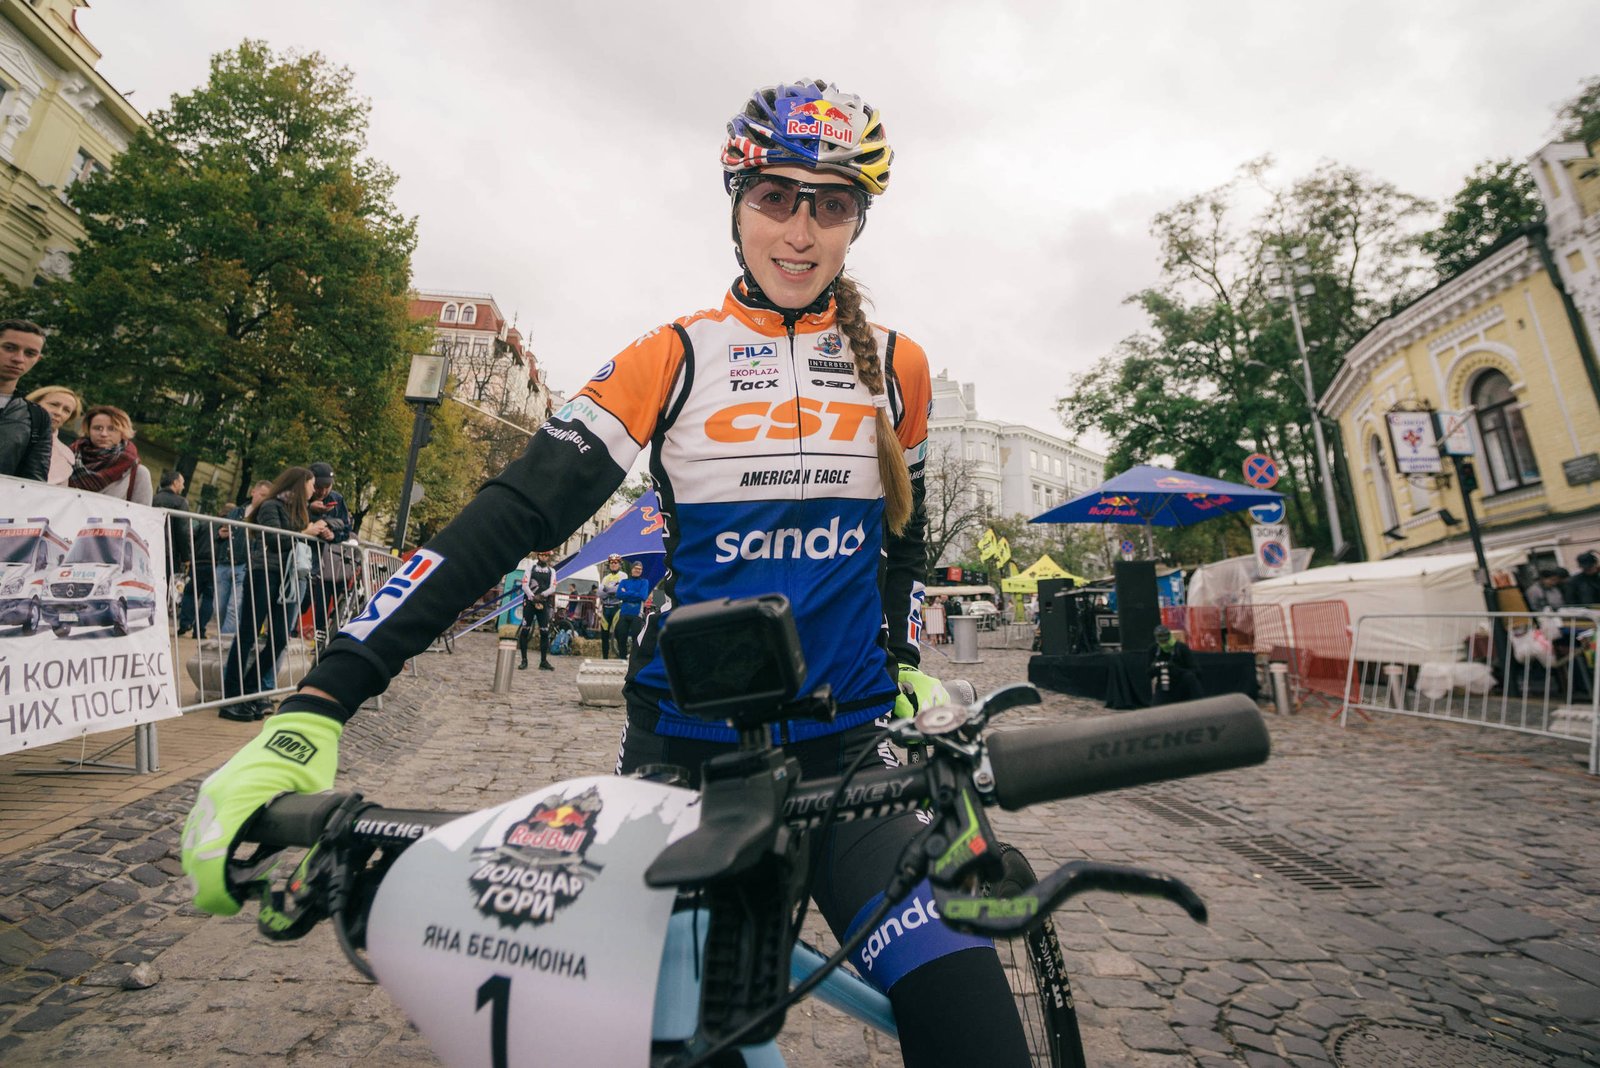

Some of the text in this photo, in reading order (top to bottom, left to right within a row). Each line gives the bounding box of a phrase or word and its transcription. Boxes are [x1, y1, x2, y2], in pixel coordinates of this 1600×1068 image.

[787, 120, 853, 143] Red Bull
[733, 346, 773, 360] FILA
[730, 368, 779, 377] EKOPLAZA
[730, 379, 779, 391] Tacx
[704, 397, 877, 443] CST
[740, 469, 851, 487] AMERICAN EAGLE
[348, 555, 433, 623] FILA
[24, 652, 167, 693] КОМПЛЕКС
[72, 683, 169, 722] ПОСЛУГ
[273, 734, 310, 760] 100%
[1087, 724, 1226, 761] RITCHEY
[507, 824, 588, 853] Red Bull
[473, 862, 584, 897] ВОЛОДАР
[478, 884, 556, 923] ГОРИ
[422, 925, 588, 980] ЯНА БЕЛОМОІНА
[474, 973, 512, 1068] 1
